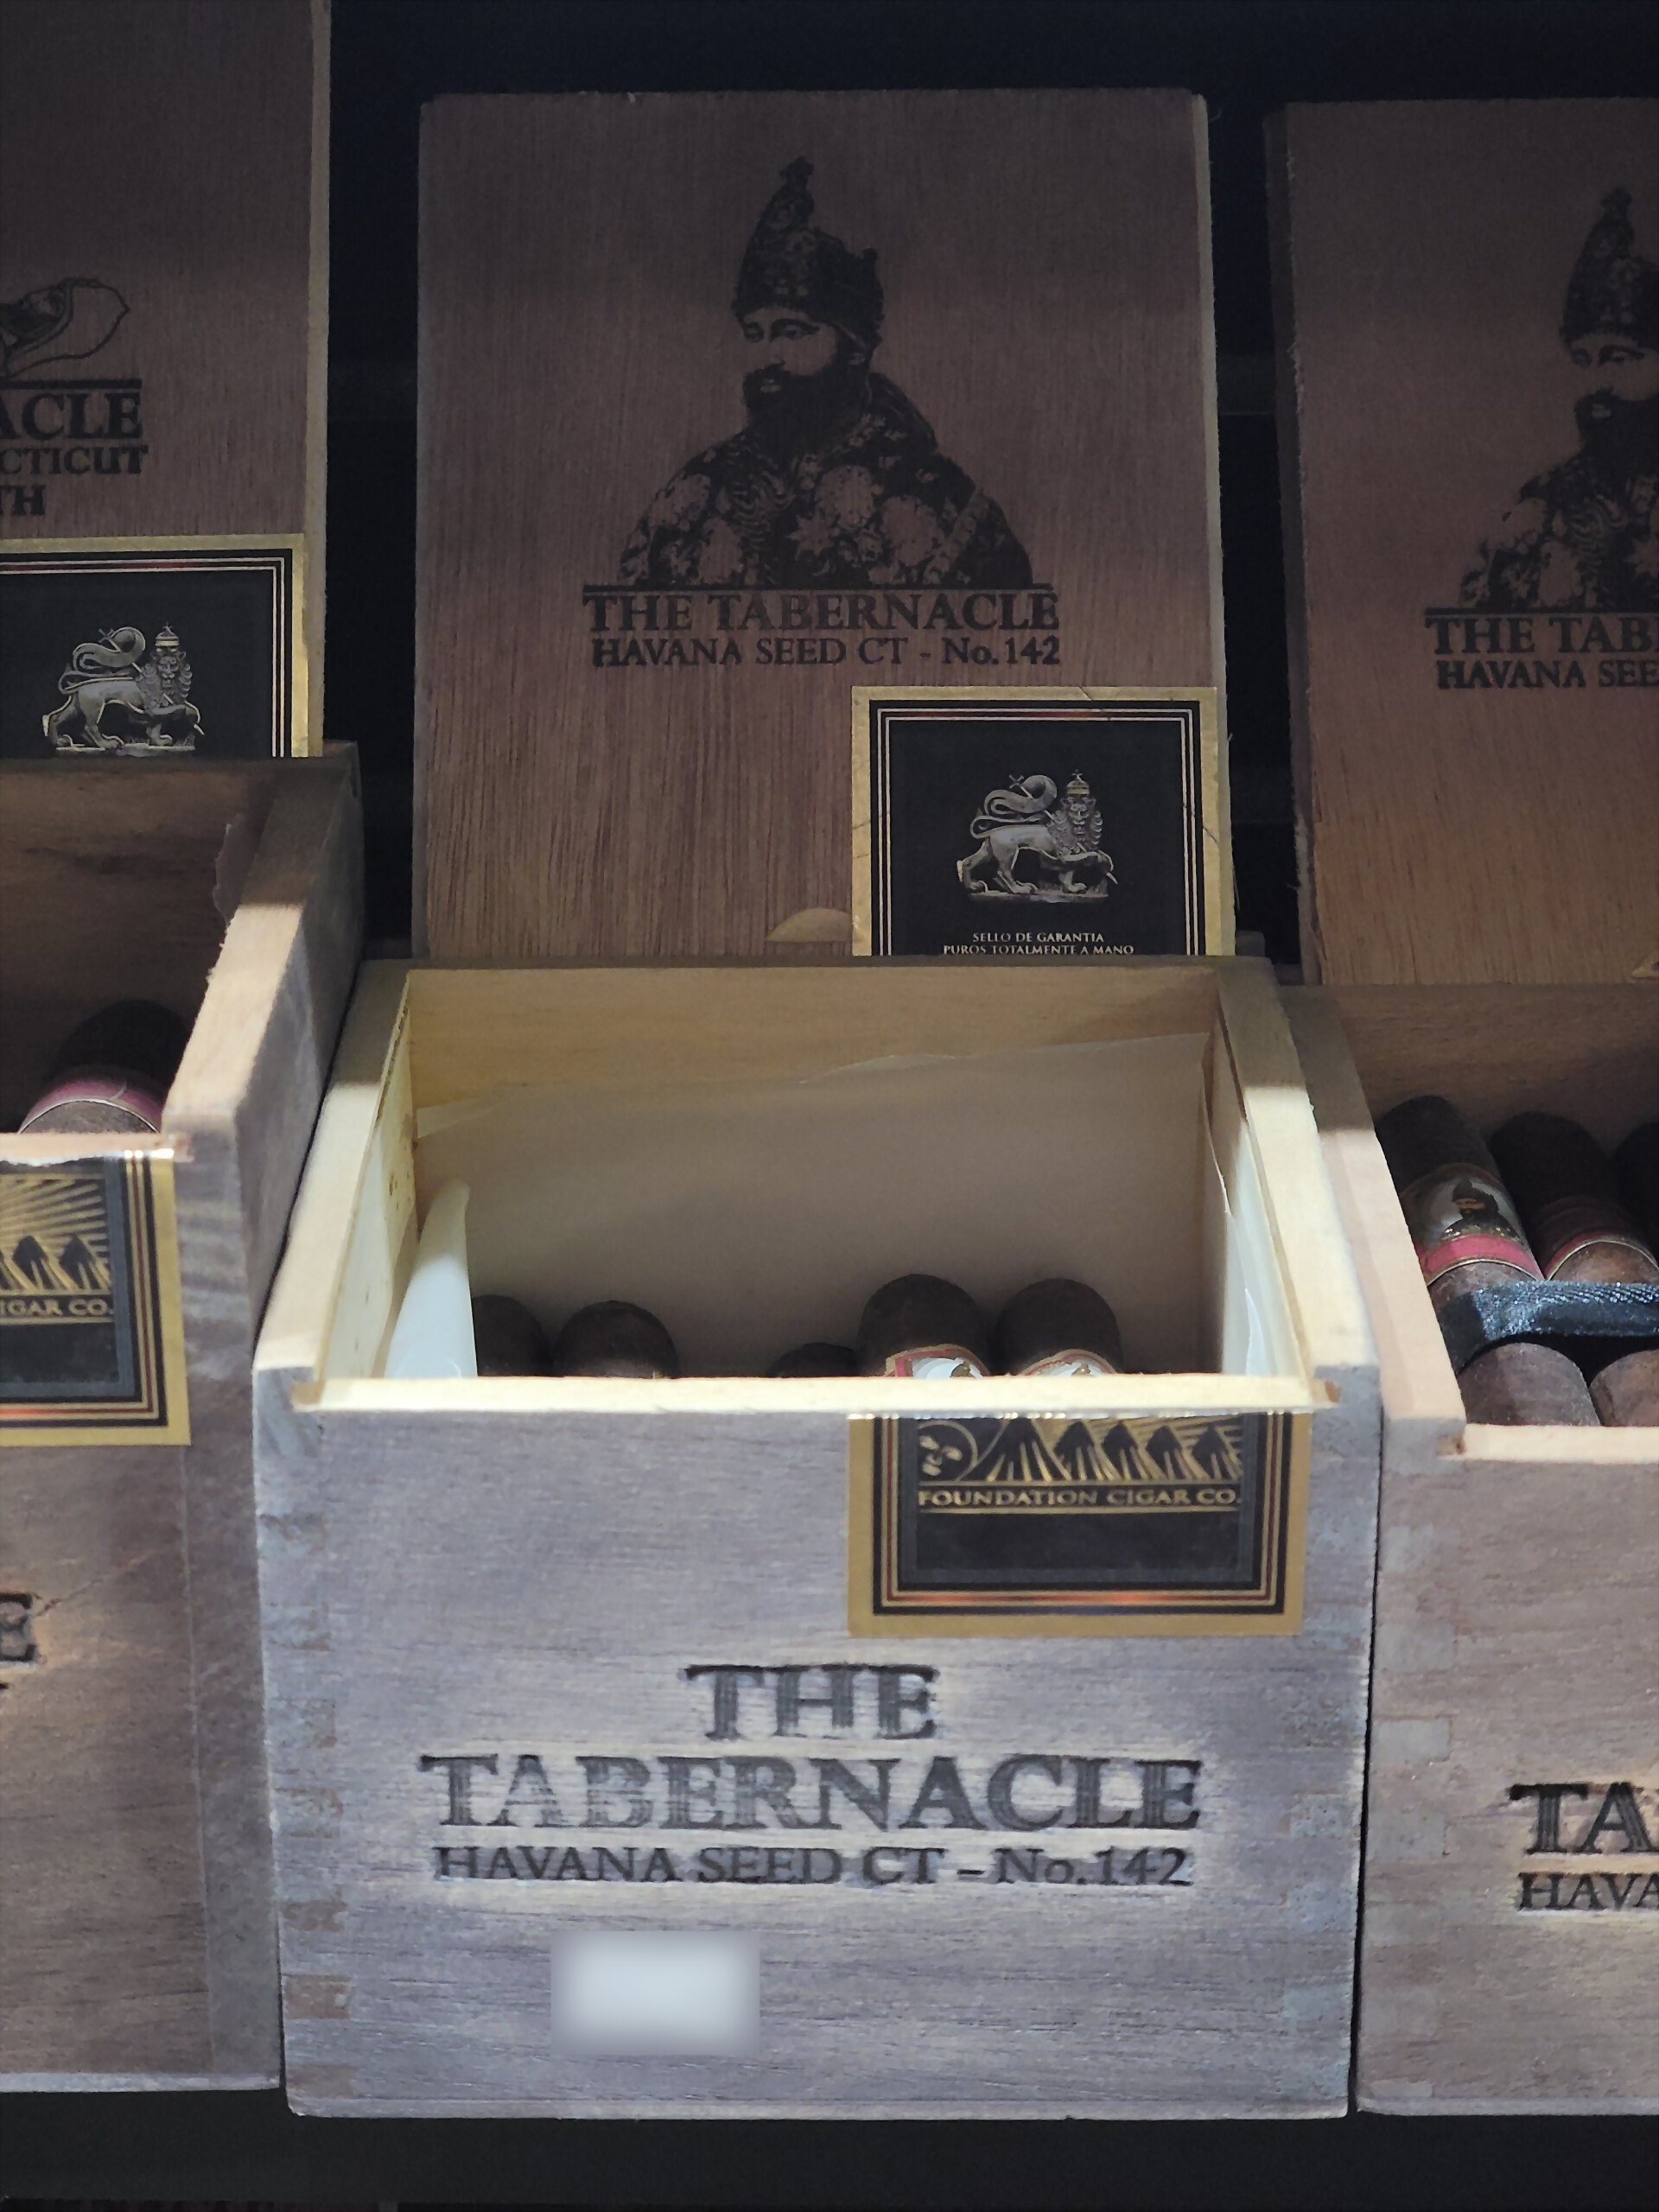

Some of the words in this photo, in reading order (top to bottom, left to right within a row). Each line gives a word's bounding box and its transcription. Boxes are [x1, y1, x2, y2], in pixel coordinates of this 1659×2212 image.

[582, 593, 693, 632] THE
[706, 592, 1060, 632] TABERNACLE
[591, 637, 743, 668] HAVANA
[755, 636, 847, 665] SEED
[858, 636, 909, 665] CT
[942, 634, 1061, 666] No.142
[1424, 616, 1536, 655] THE
[1436, 659, 1586, 689] HAVANA
[1599, 658, 1659, 688] SEE
[943, 944, 987, 955] PUROS
[993, 944, 1077, 955] TOTALMENTE
[1080, 944, 1090, 955] A
[1092, 944, 1135, 955] MANO
[972, 932, 1012, 943] SELLO
[1015, 932, 1033, 943] DE
[1036, 932, 1105, 943] GARANTIA
[918, 1488, 1097, 1507] FOUNDATION
[1106, 1488, 1192, 1506] CIGAR
[1196, 1488, 1243, 1506] CO.
[683, 1662, 939, 1740] THE
[418, 1751, 1202, 1832] TABERNACLE
[1508, 1782, 1659, 1854] TA
[433, 1845, 683, 1883] HAVANA
[696, 1845, 842, 1884] SEED
[862, 1846, 946, 1885] CT
[992, 1845, 1195, 1886] No.142
